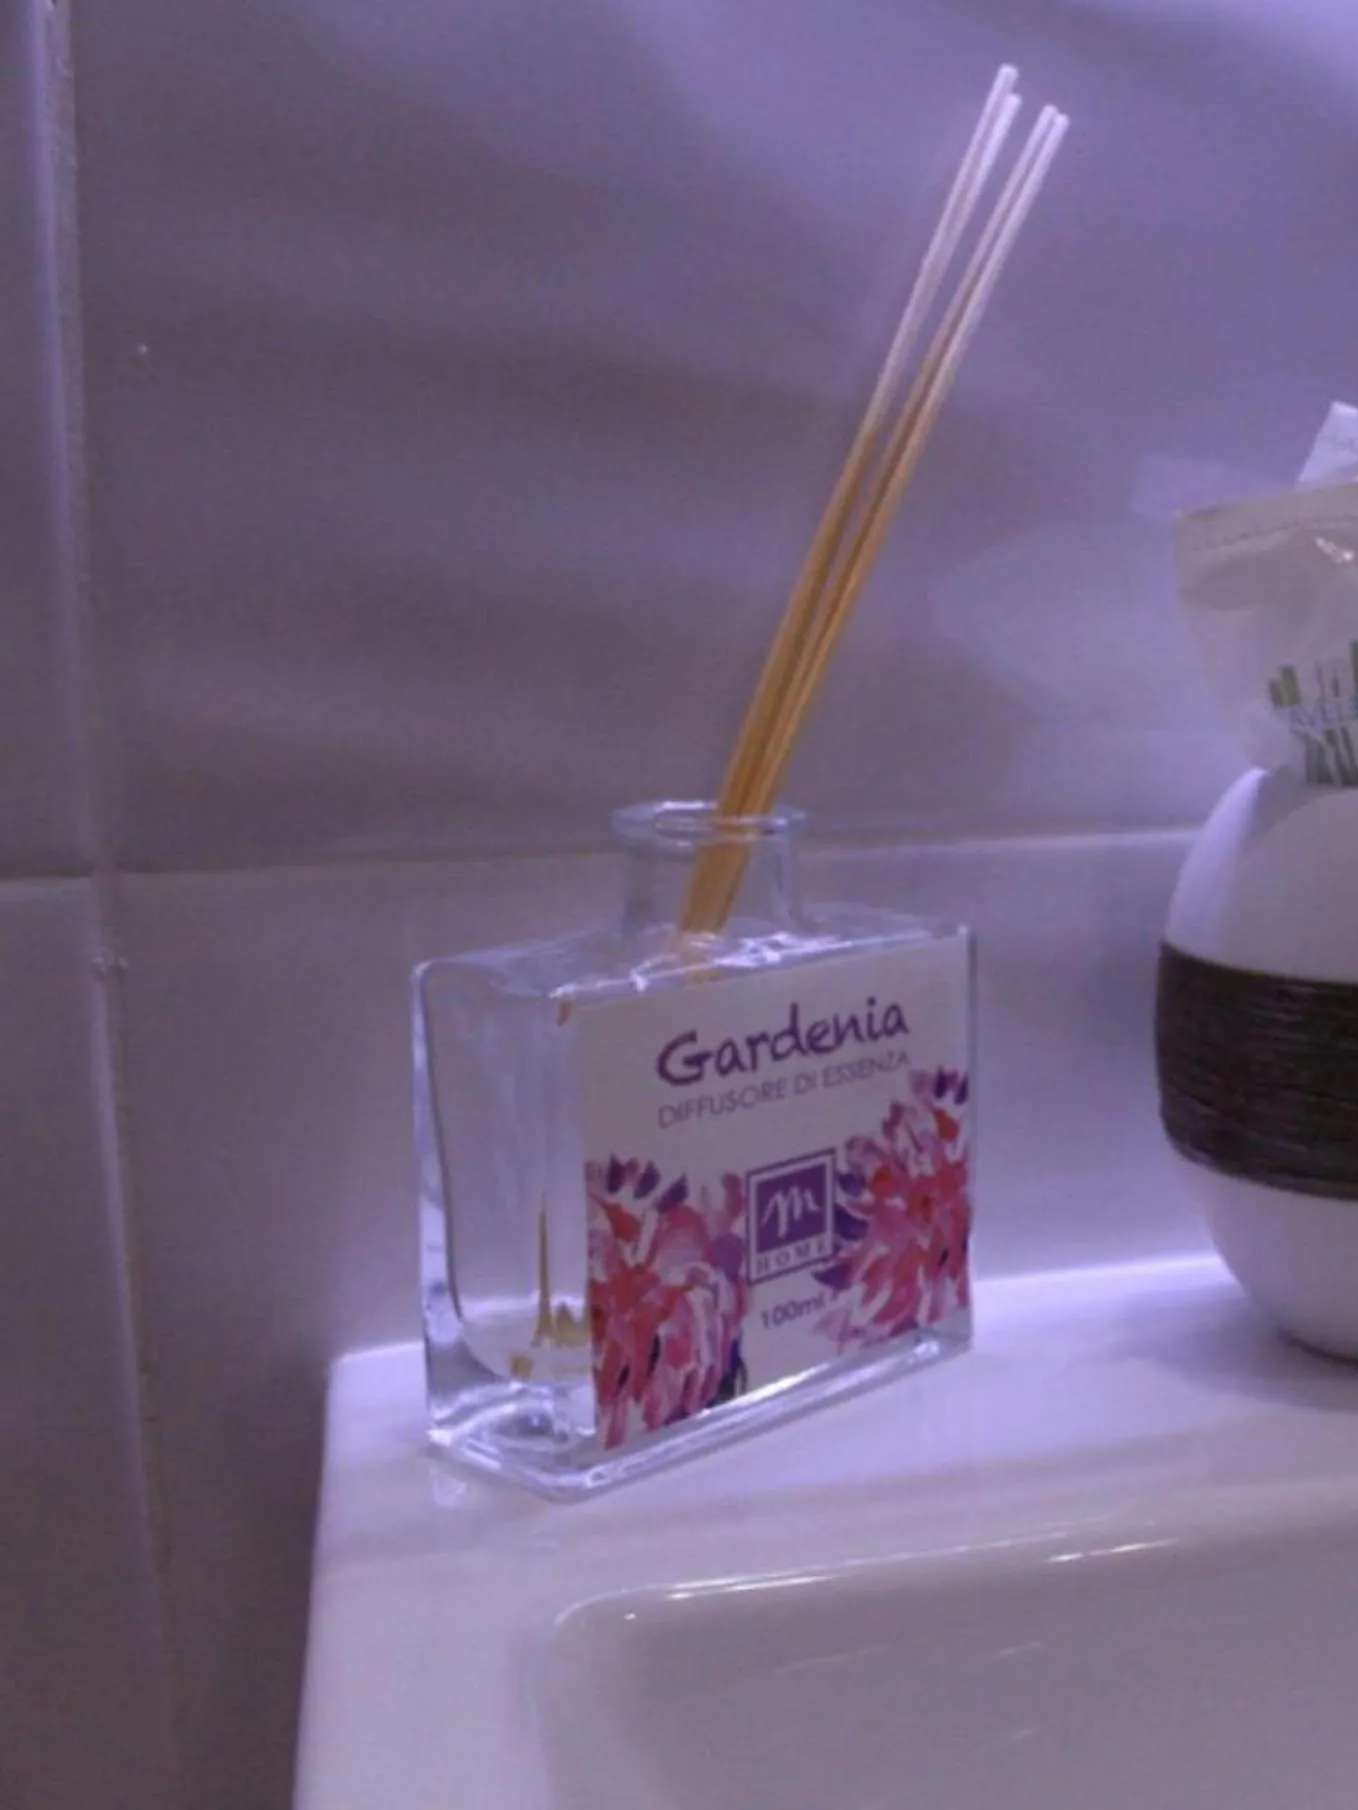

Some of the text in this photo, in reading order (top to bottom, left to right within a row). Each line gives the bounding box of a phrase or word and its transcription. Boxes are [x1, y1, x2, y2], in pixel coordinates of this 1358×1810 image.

[657, 996, 910, 1087] Gardenia
[658, 1049, 911, 1130] DIFFUSORE DI ESSENZA
[756, 1242, 828, 1276] HOME
[760, 1292, 826, 1331] 100ml
